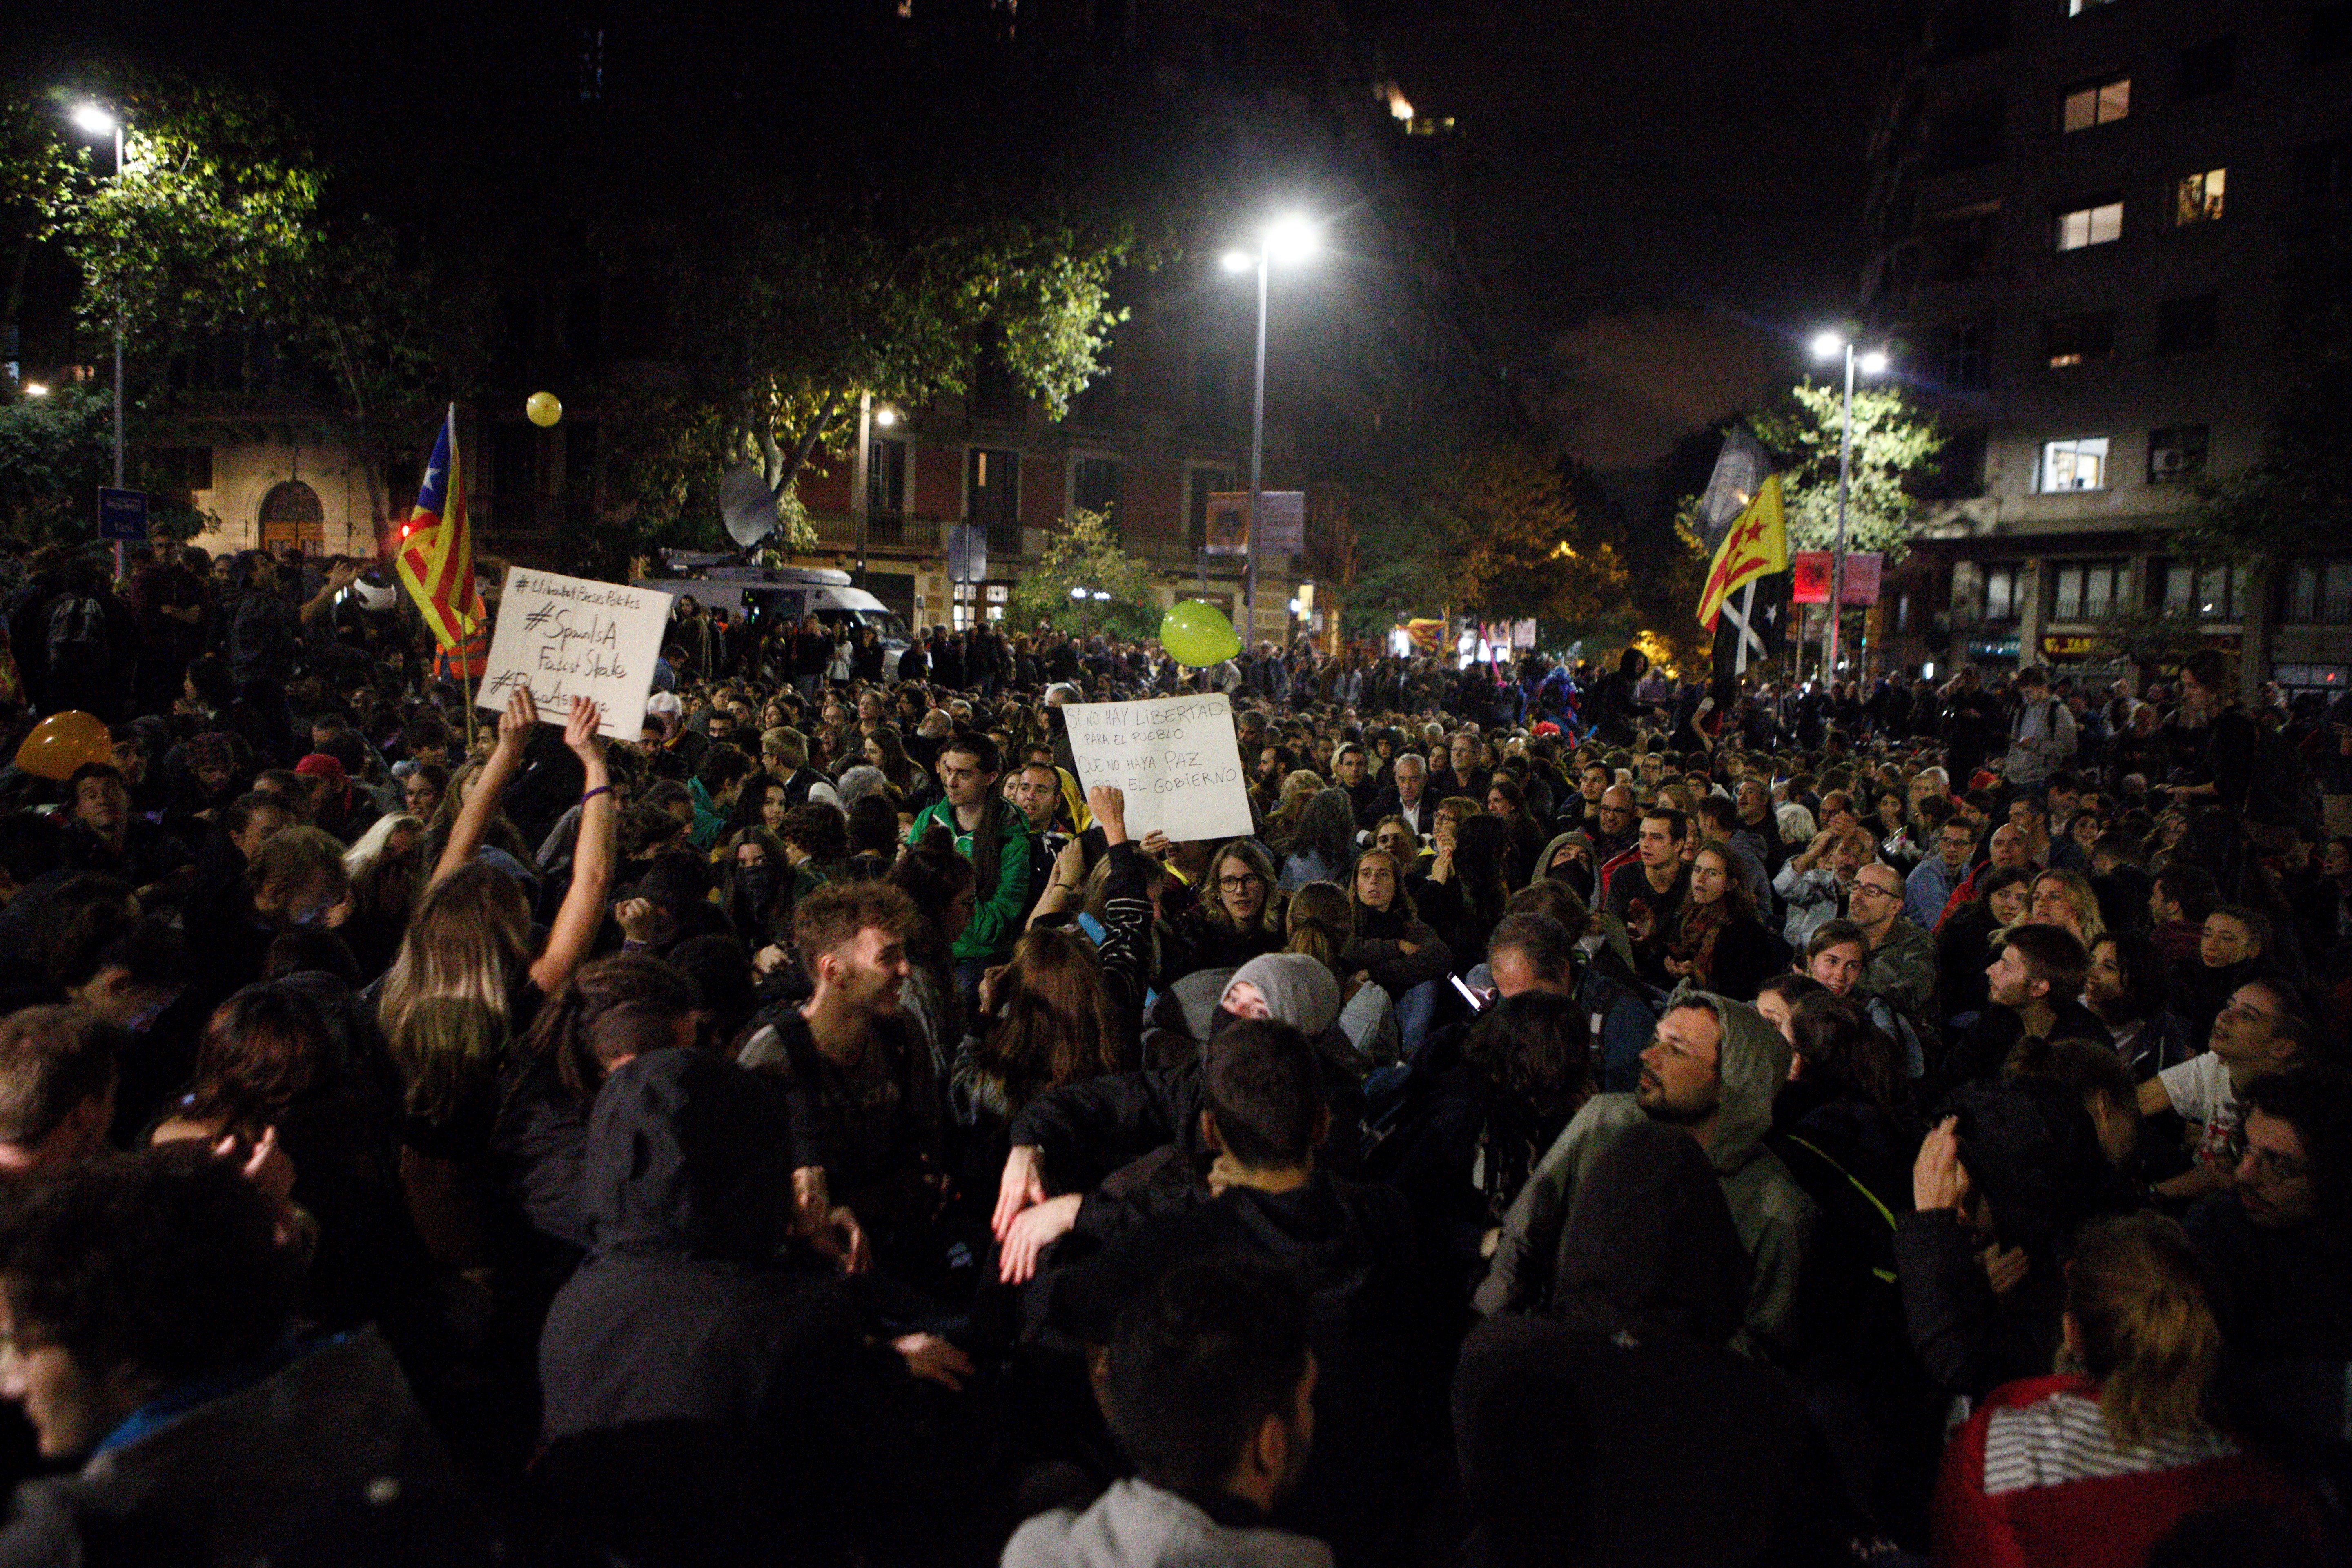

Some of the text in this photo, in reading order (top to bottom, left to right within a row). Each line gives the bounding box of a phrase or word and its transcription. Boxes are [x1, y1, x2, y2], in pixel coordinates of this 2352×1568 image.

[1087, 710, 1099, 726] NO
[1106, 707, 1128, 728] HAY
[1084, 728, 1184, 745] PARA EL PUEBLO
[1078, 751, 1203, 776] QUE NO HAYA PAZ
[1129, 778, 1147, 791] EL
